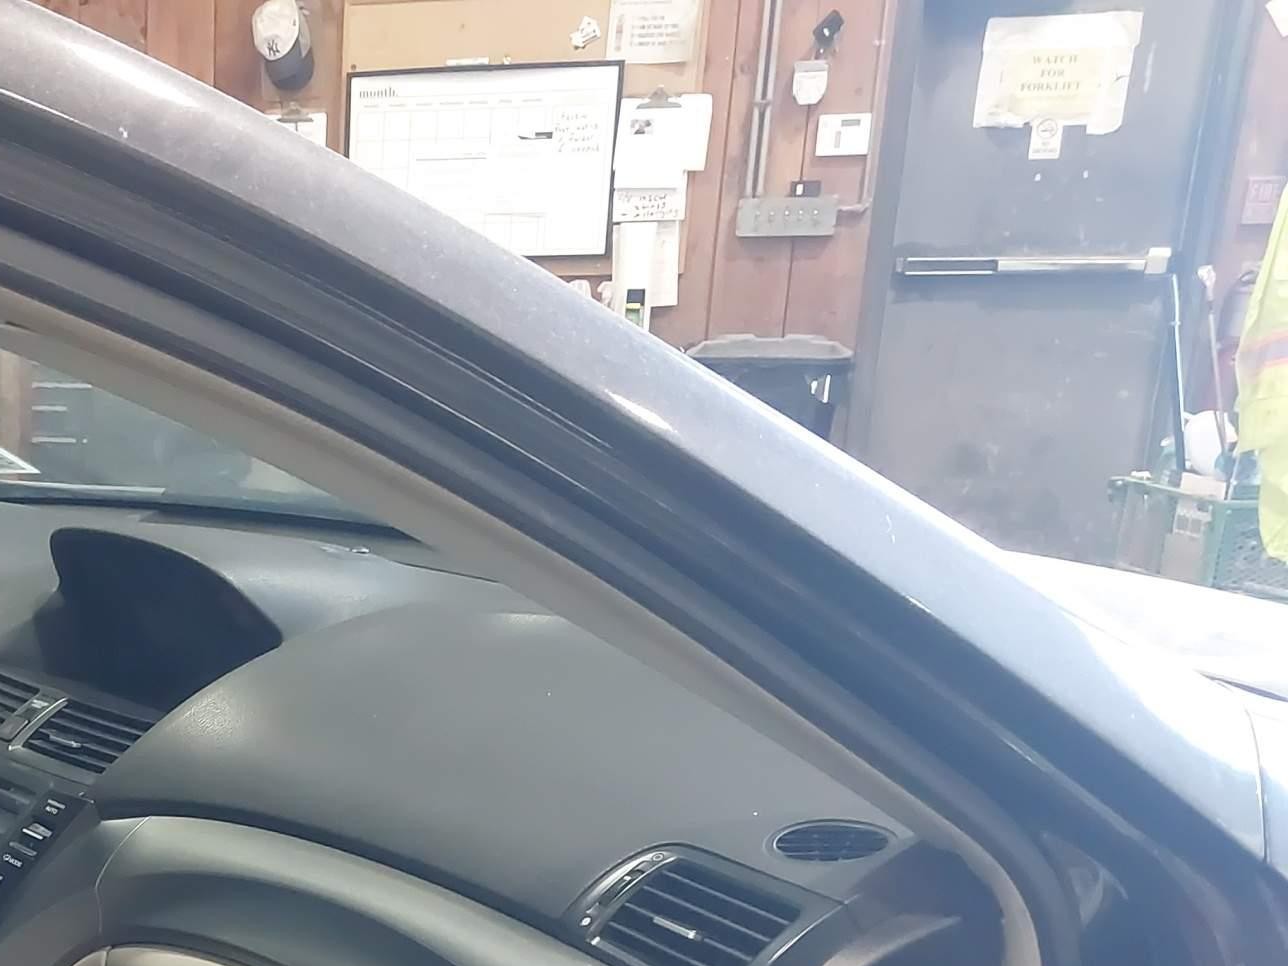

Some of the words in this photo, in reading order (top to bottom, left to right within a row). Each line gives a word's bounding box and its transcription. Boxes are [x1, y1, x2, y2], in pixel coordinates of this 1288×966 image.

[1032, 55, 1079, 65] WATCH
[1040, 68, 1065, 79] FOR
[1019, 80, 1081, 92] FORKLIFT
